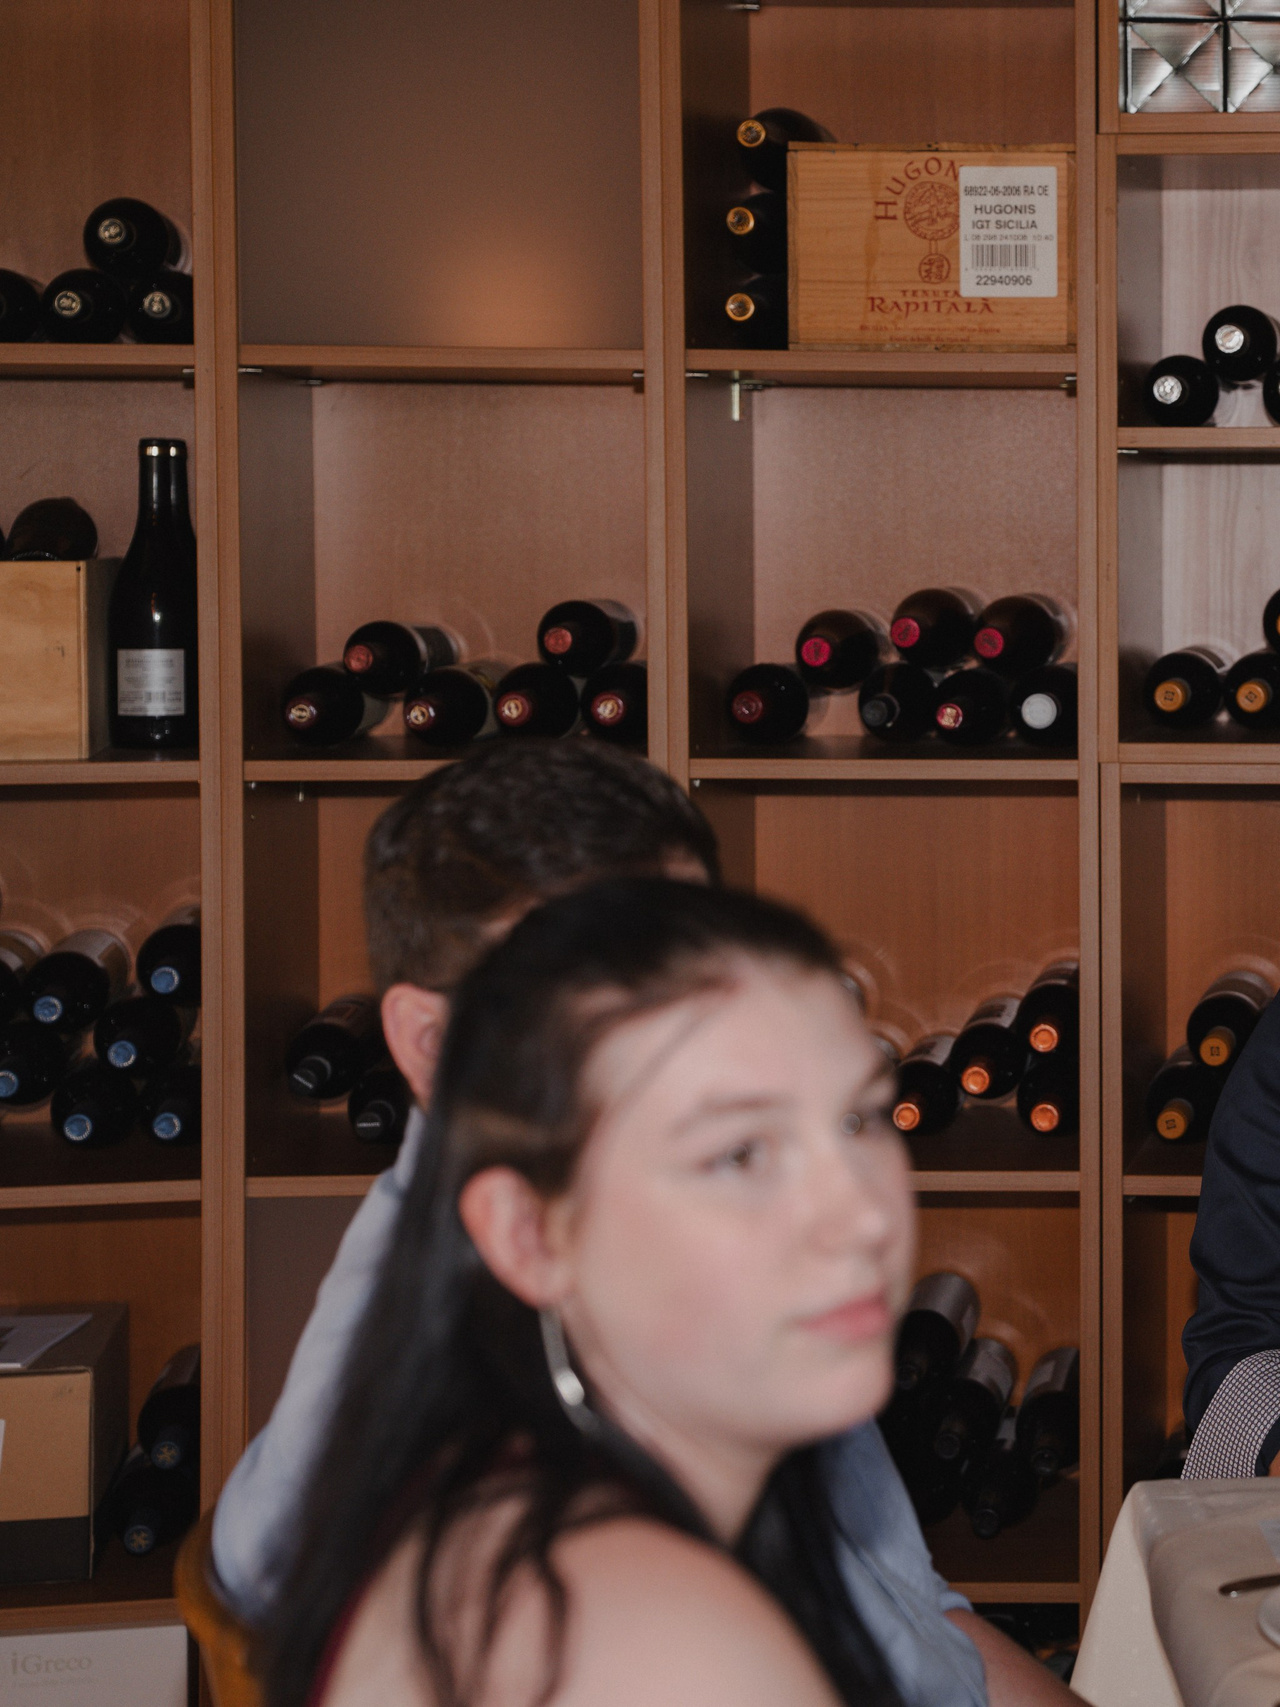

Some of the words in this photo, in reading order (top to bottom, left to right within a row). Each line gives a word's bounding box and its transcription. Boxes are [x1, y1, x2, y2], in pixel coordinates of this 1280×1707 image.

[873, 156, 963, 222] HUGON
[974, 204, 1036, 215] HUGONIS
[972, 219, 991, 230] IGT
[995, 219, 1038, 230] SICILIA
[976, 275, 1033, 286] 22940906
